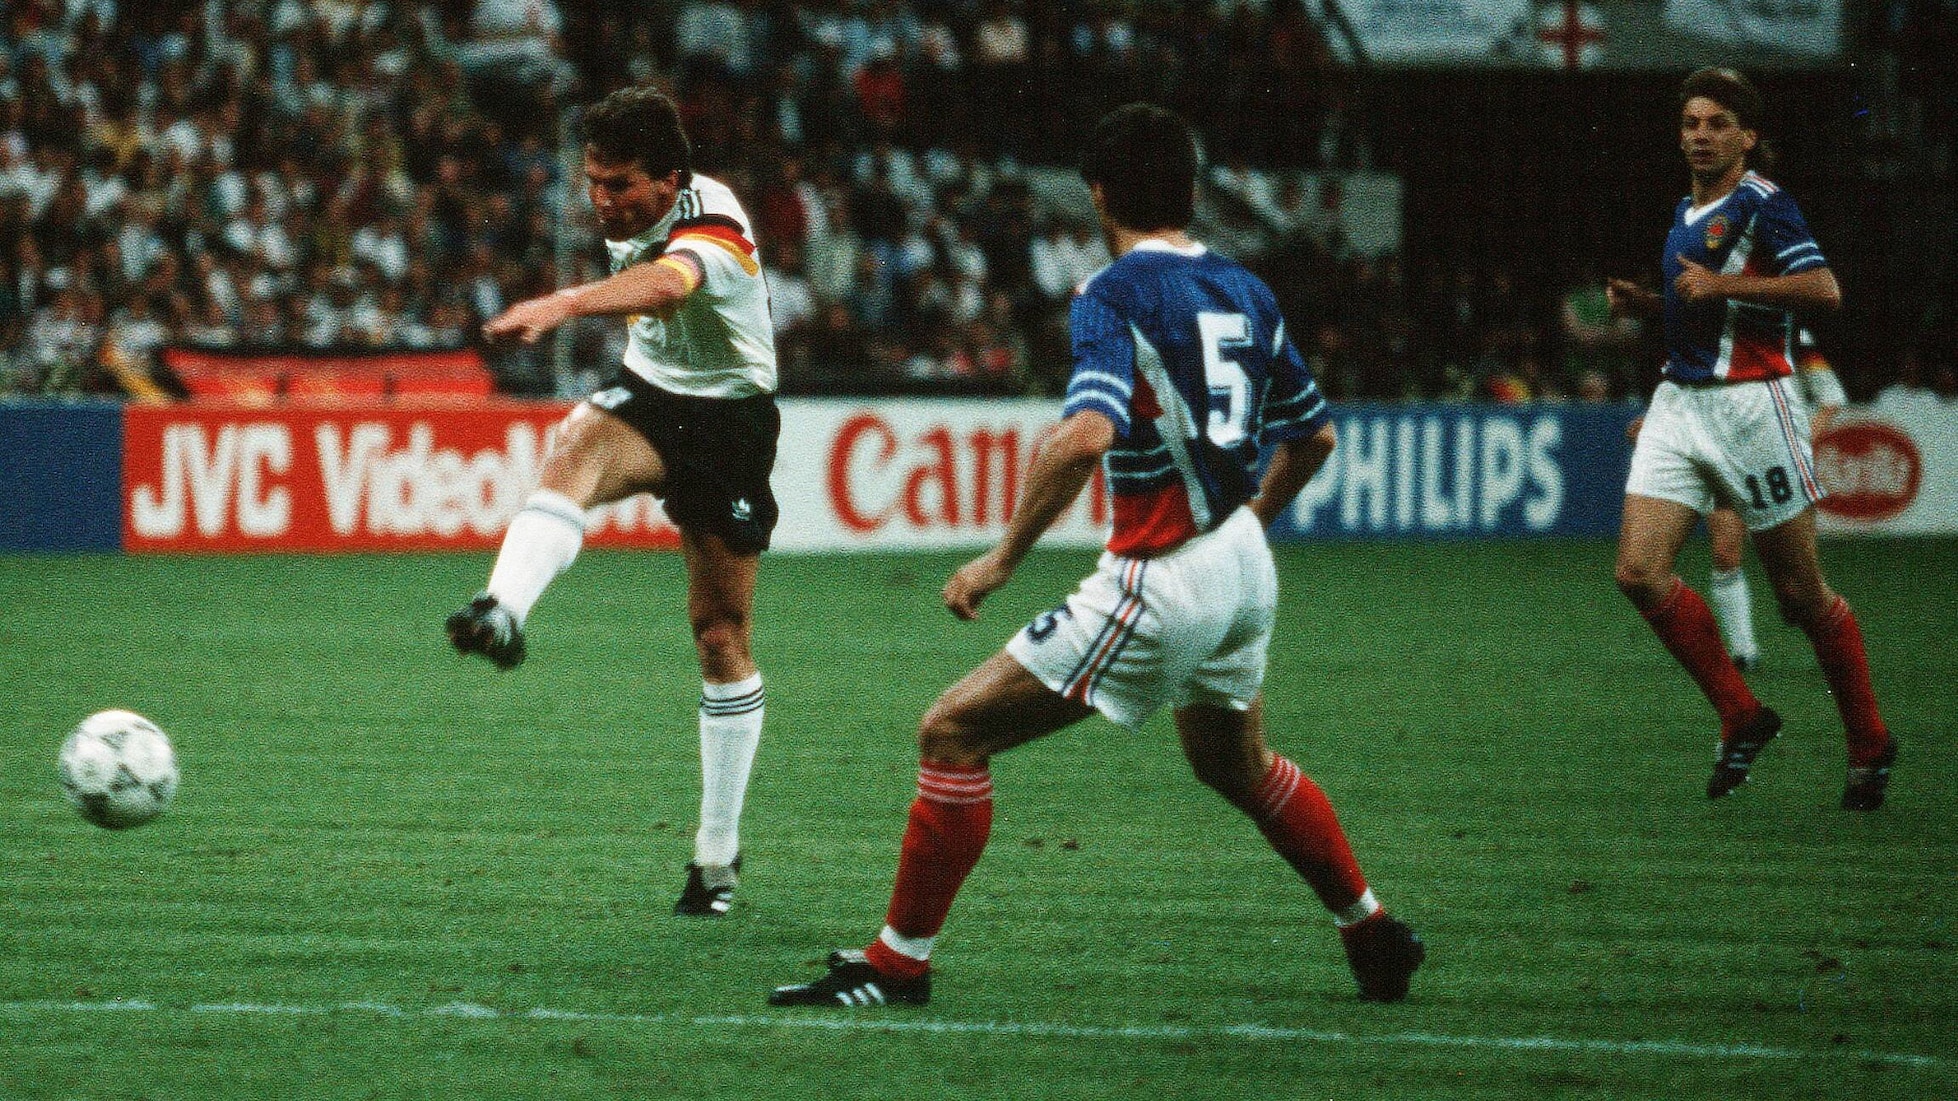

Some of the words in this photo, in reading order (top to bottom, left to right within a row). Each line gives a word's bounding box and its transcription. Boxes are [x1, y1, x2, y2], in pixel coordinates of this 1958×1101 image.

[1197, 312, 1249, 447] 5
[132, 421, 293, 538] JVC
[1746, 466, 1792, 508] 18
